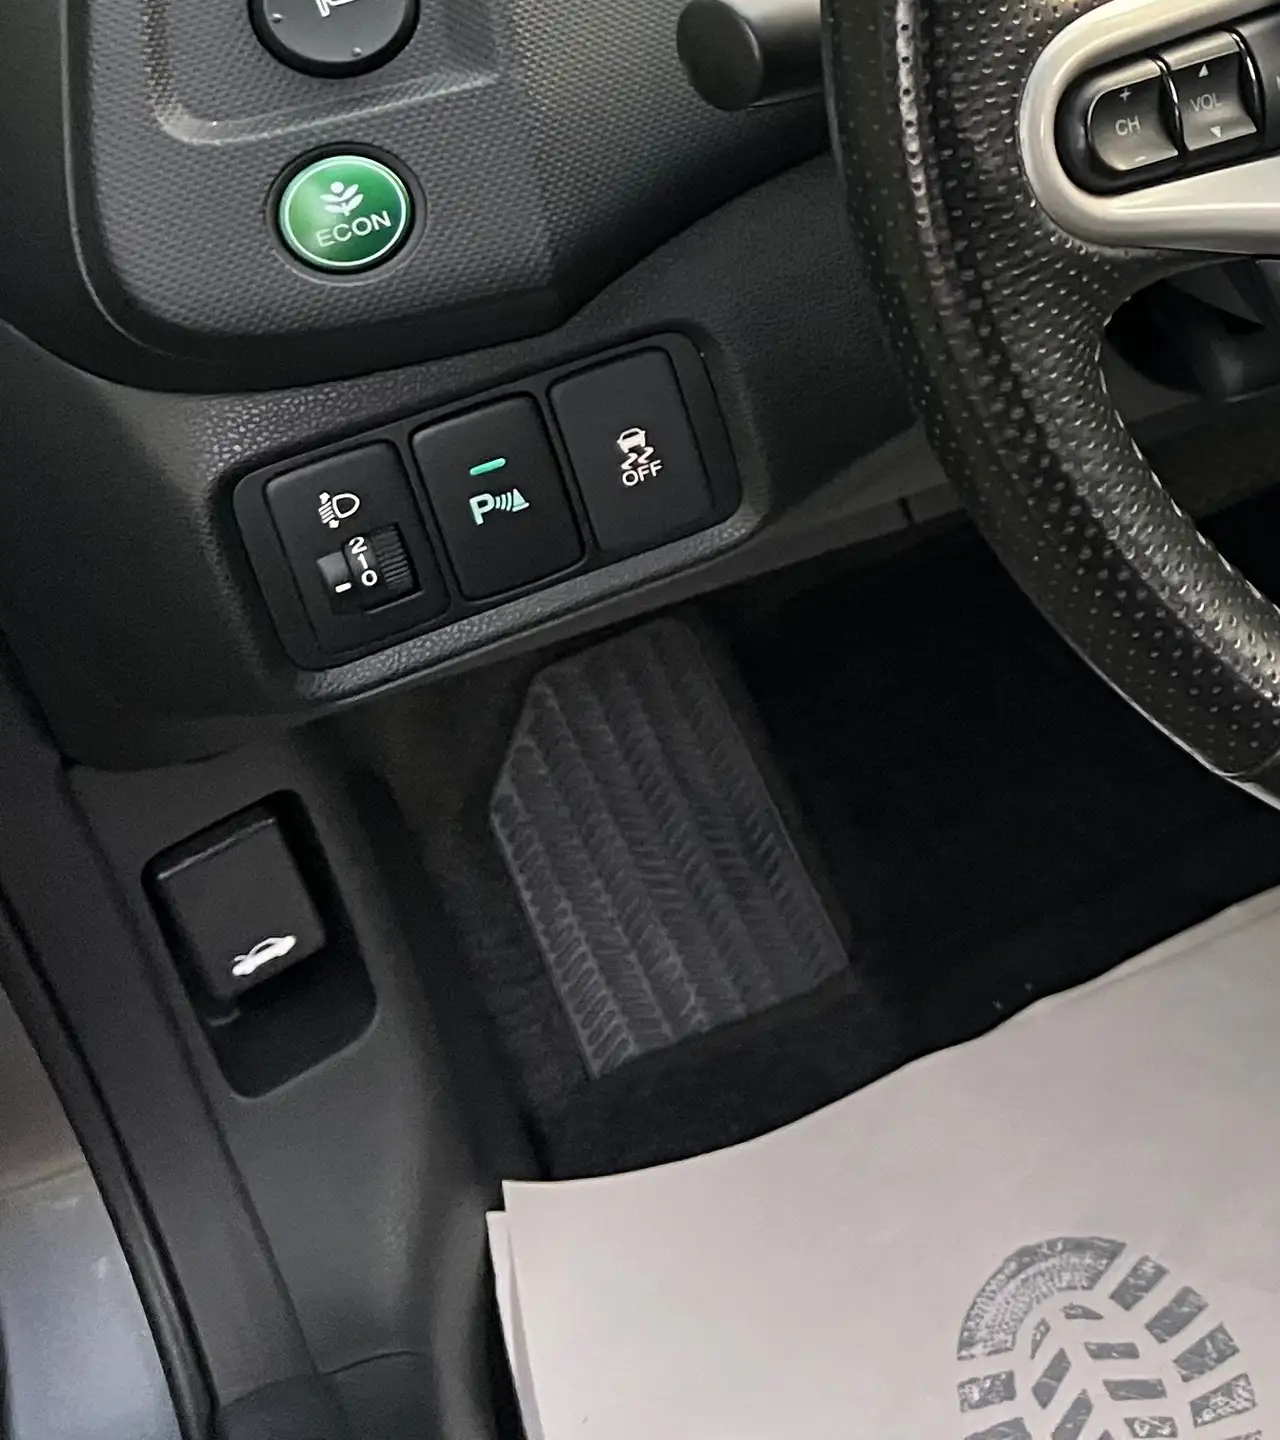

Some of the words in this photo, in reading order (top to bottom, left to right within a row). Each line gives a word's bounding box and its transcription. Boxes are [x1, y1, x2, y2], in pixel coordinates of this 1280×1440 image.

[1189, 92, 1224, 112] VOL
[1114, 115, 1142, 137] CH
[315, 210, 393, 250] ECON
[621, 459, 664, 488] OFF
[347, 535, 368, 555] 2
[357, 552, 369, 569] 1
[360, 568, 379, 587] 0
